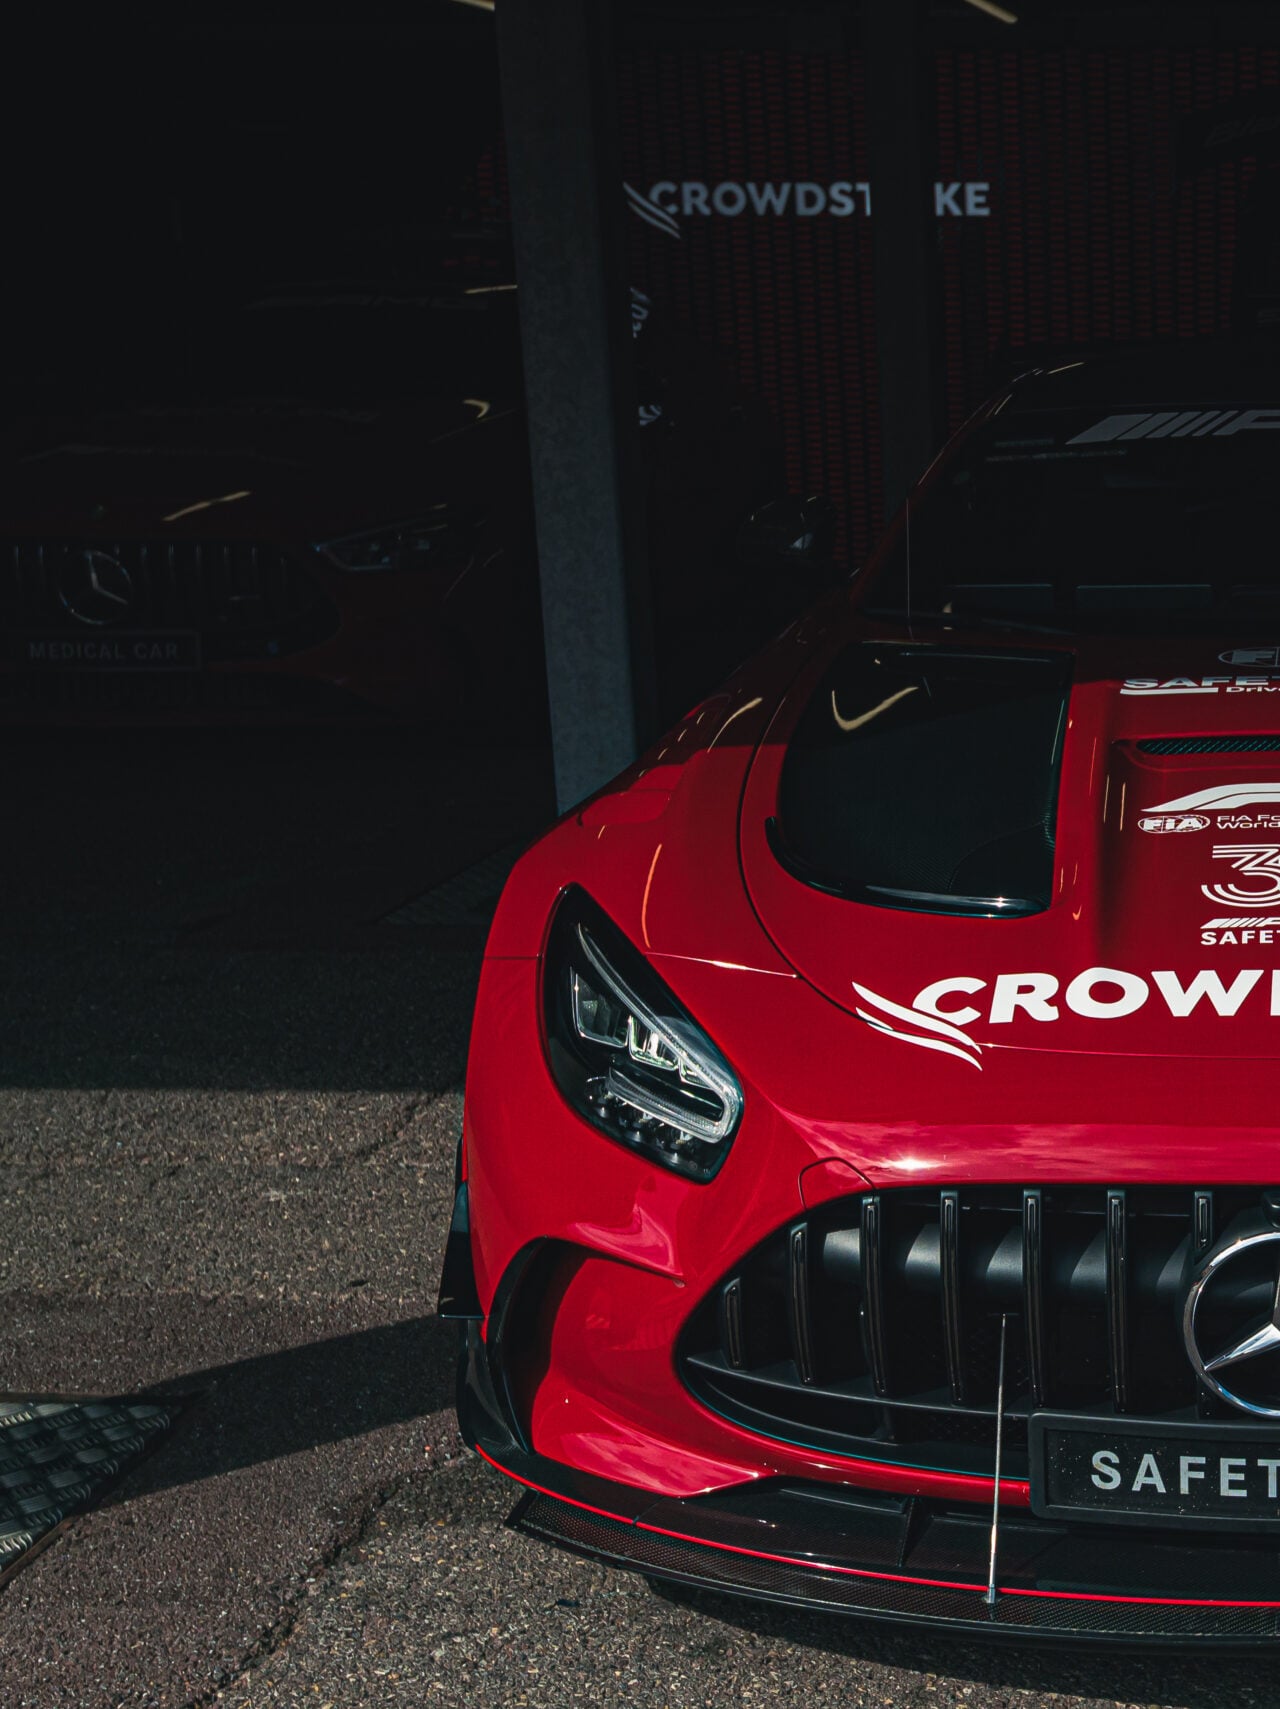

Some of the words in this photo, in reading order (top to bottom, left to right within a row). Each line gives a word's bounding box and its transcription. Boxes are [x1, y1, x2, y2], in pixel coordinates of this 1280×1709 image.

[648, 181, 991, 217] CROWDSTKE
[28, 641, 125, 660] MEDICAL
[133, 641, 178, 660] CAR
[1143, 816, 1205, 832] FIA
[1216, 821, 1280, 830] World
